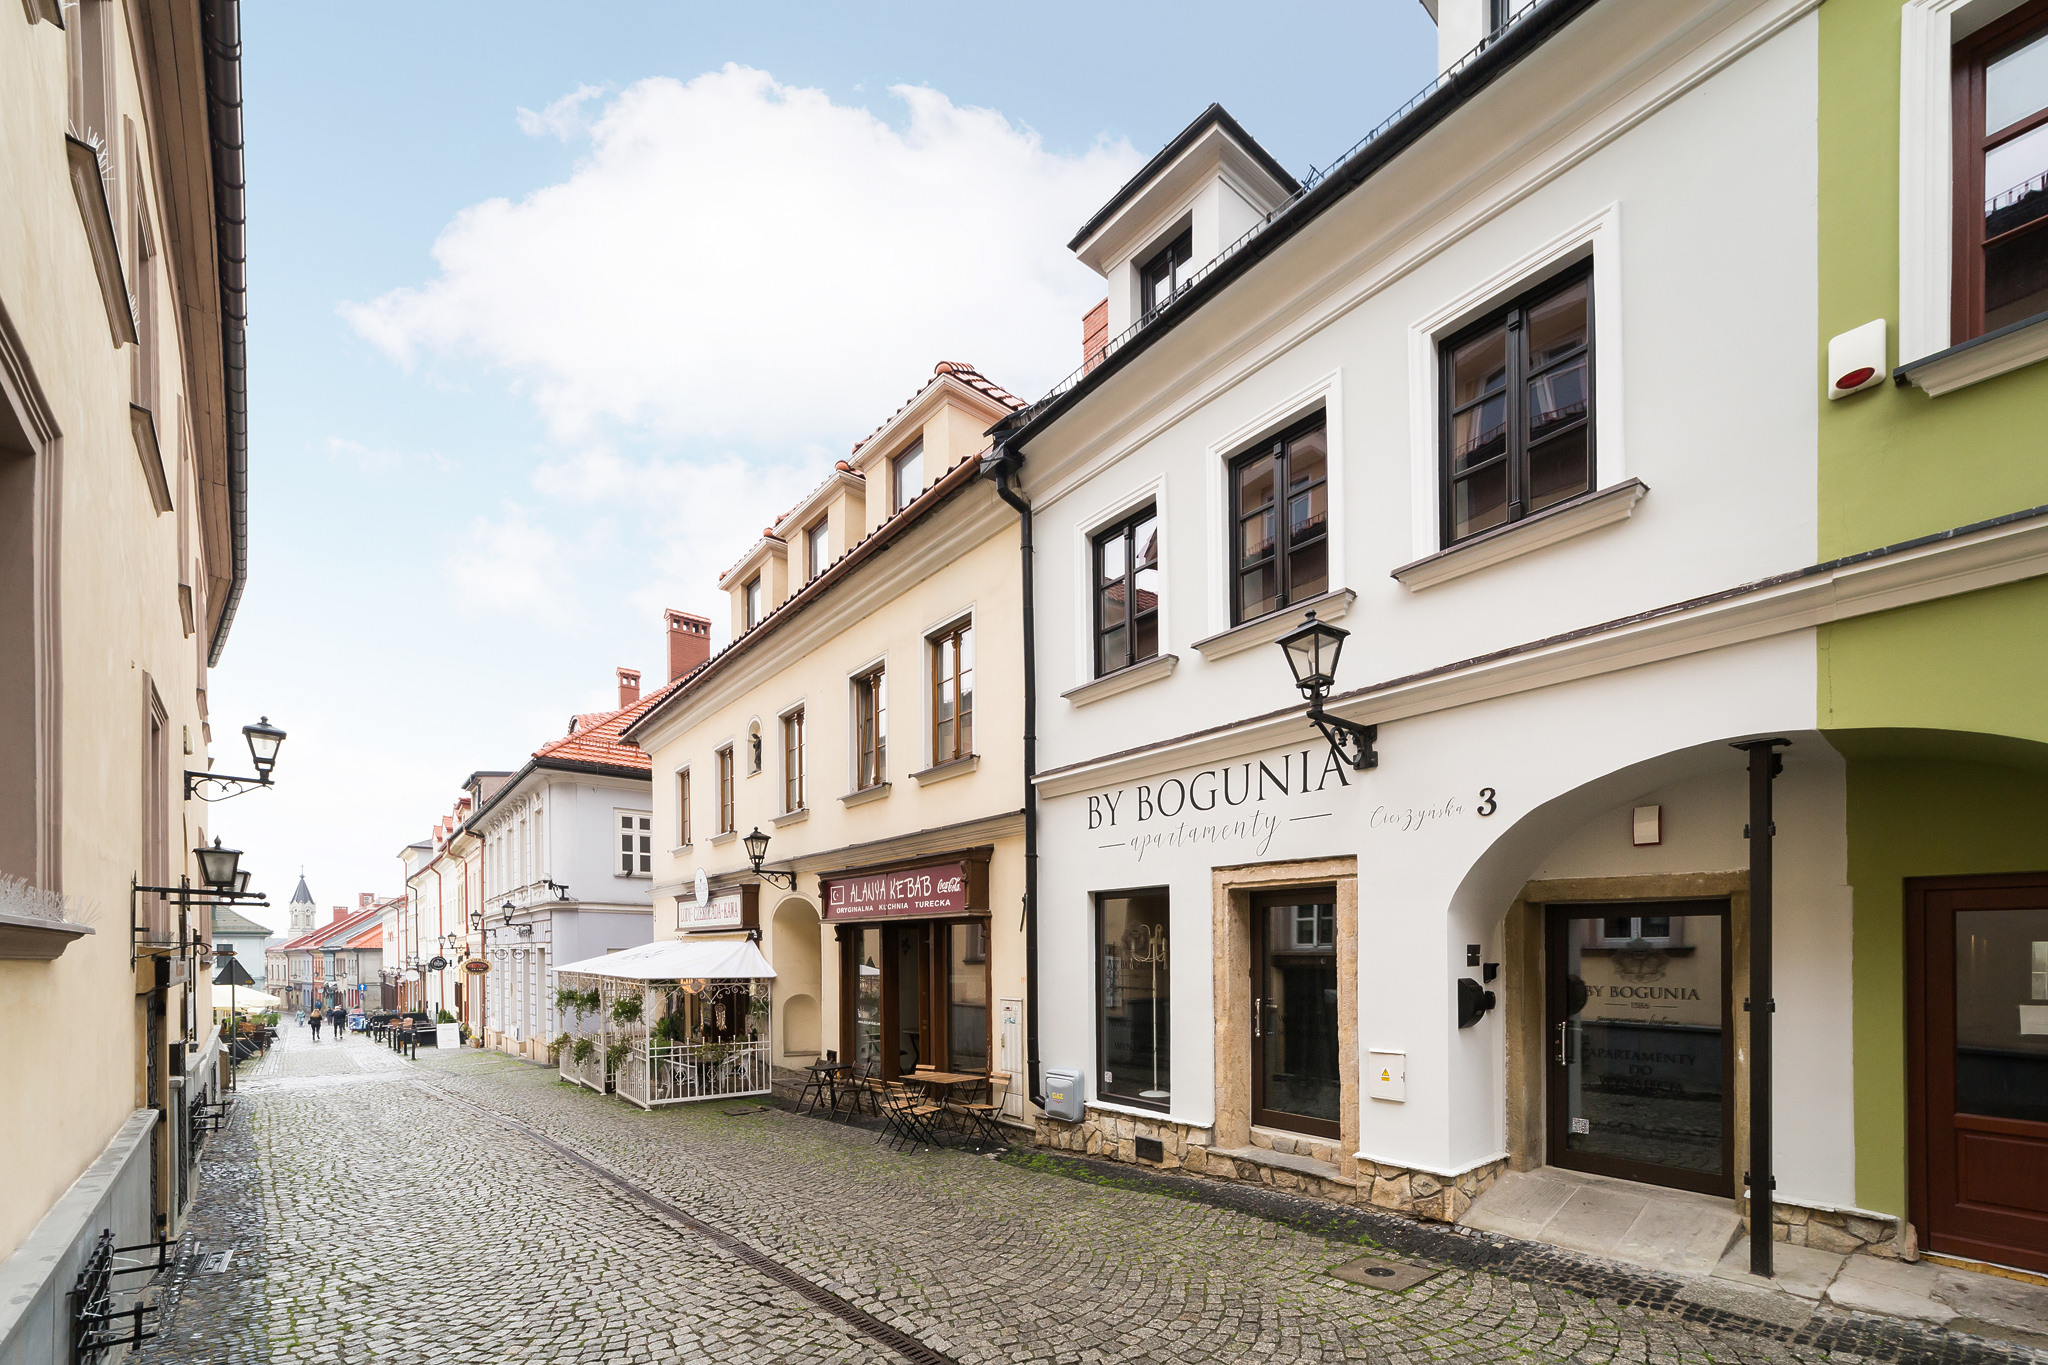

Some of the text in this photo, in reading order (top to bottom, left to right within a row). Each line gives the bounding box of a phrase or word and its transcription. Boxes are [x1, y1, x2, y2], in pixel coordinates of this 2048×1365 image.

[1087, 743, 1352, 830] BY BOGUNIA
[1476, 787, 1498, 817] 3
[1130, 809, 1281, 862] apartamenty
[850, 879, 886, 903] ALANYA
[889, 875, 932, 900] KEBAB
[836, 899, 951, 914] ORYGINALNA KUCHNIA TURECKA
[1584, 985, 1701, 1001] BY BOGUNIA
[1588, 1048, 1698, 1065] APARTAMENTY
[1628, 1064, 1652, 1076] DO
[1051, 1092, 1064, 1101] GAZ
